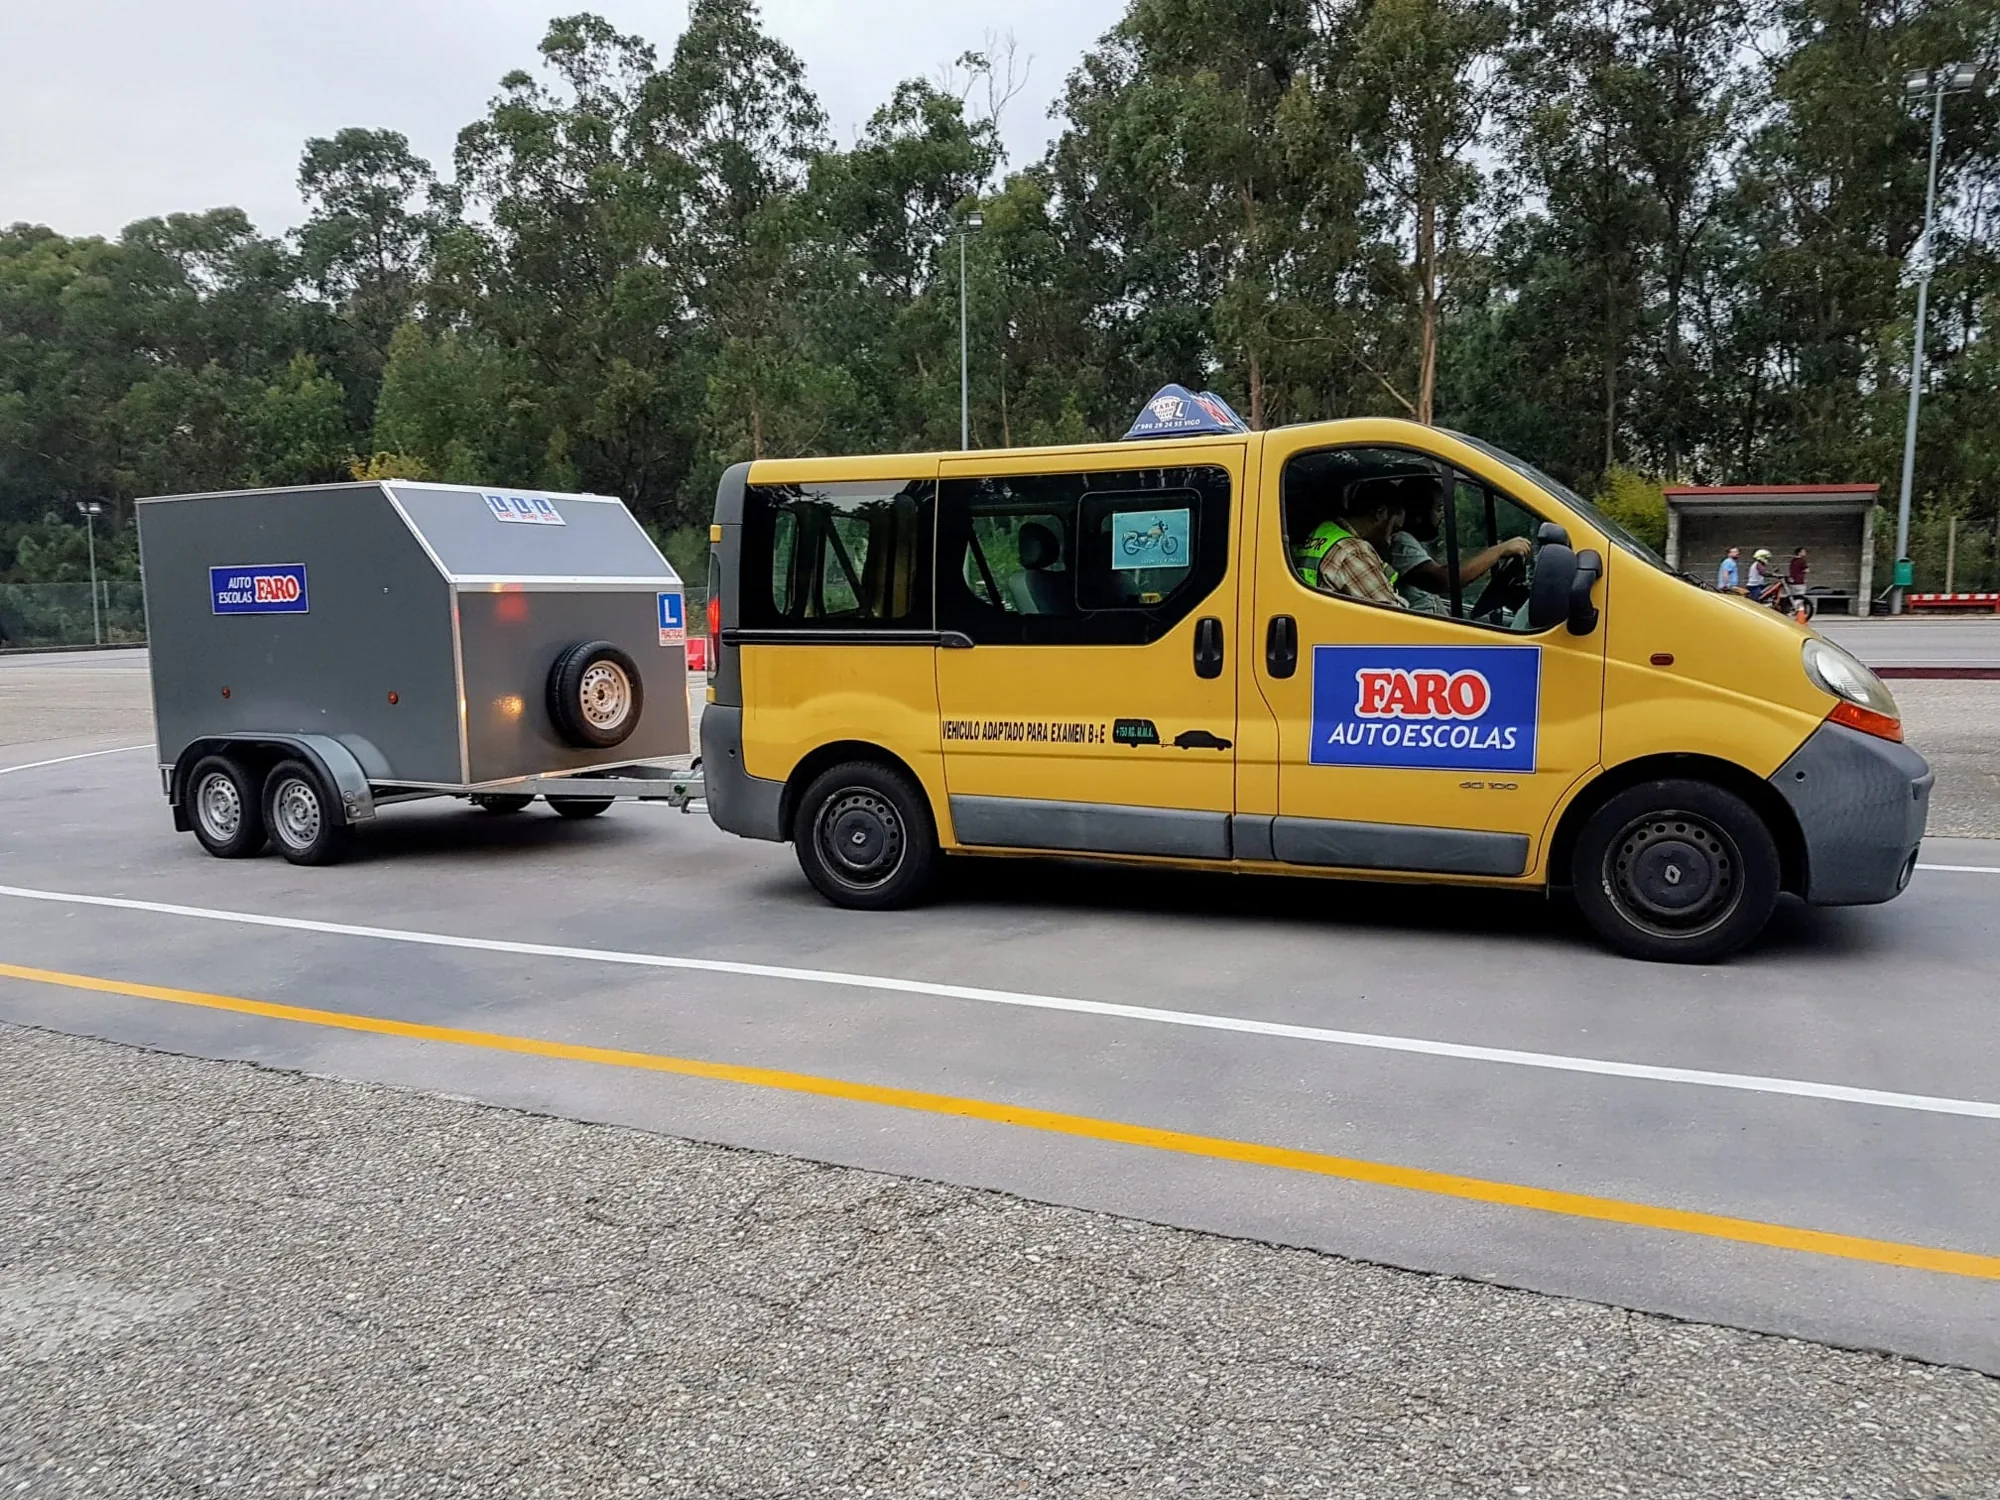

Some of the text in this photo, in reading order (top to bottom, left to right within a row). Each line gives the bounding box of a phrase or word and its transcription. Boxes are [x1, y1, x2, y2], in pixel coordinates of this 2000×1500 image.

[228, 576, 252, 589] AUTO
[254, 576, 300, 602] FARO
[218, 591, 253, 604] ESCOLAS
[664, 599, 677, 624] L
[1357, 670, 1489, 718] FARO
[942, 720, 980, 740] VEHICULO
[981, 721, 1025, 741] ADAPTADO
[1026, 722, 1048, 742] PARA
[1050, 722, 1086, 743] EXAMEN
[1328, 722, 1518, 750] AUTOESCOLAS
